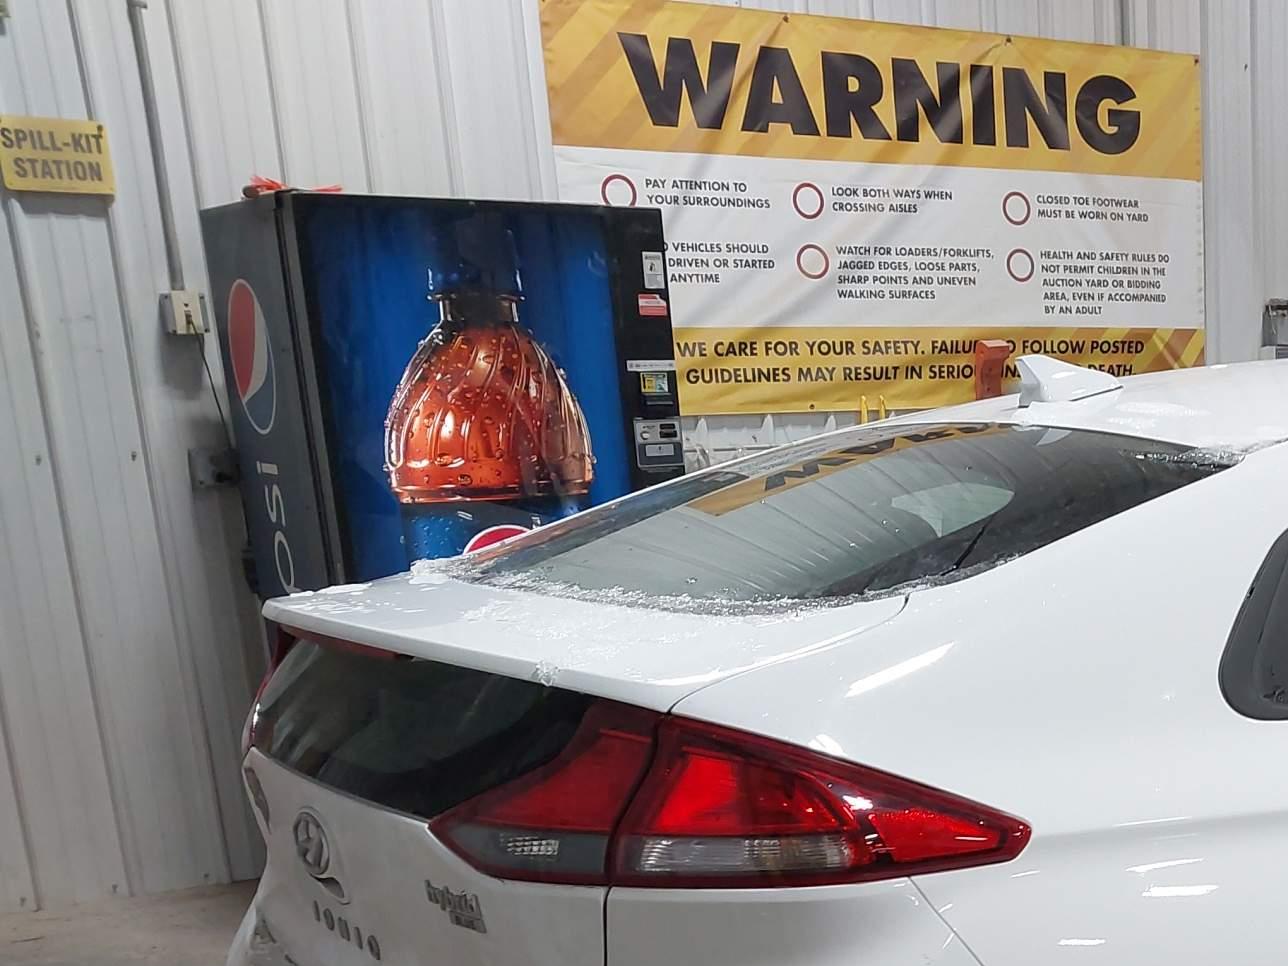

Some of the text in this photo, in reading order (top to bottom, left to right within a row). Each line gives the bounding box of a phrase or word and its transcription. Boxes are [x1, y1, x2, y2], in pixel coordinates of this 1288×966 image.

[617, 32, 1141, 155] WARNING
[0, 127, 103, 154] SPILL-KIT
[13, 157, 103, 182] STATION
[645, 178, 748, 193] PAY ATTENTION TO
[832, 187, 953, 200] LOOK BOTH WAYS WHEN
[647, 194, 771, 209] YOUR SURROUNDINGS
[832, 202, 918, 213] CROSSING AISLES
[1037, 195, 1139, 208] CLOSED TOE FOOTWEAR
[1037, 209, 1149, 222] MUST BE WORN ON YARD
[672, 242, 722, 253] VEHICLES
[726, 243, 769, 254] SHOULD
[836, 246, 995, 259] WATCH FOR LOADERS/FORKLIFTS,
[668, 257, 775, 269] DRIVEN OR STARTED
[1040, 250, 1170, 263] HEALTH AND SAFETY RULES DO
[837, 261, 981, 273] JAGGED EDGES, LOOSE PARTS,
[1041, 264, 1166, 276] NOT PERMIT CHILDREN IN THE
[670, 273, 720, 283] ANYTIME
[837, 275, 976, 286] SHARP POINTS AND UNEVEN
[1042, 278, 1161, 289] AUCTION YARD OR BIDDING
[836, 289, 936, 299] WALKING SURFACES
[1043, 292, 1167, 303] AREA, EVEN IF ACCOMPANIED
[1044, 305, 1103, 315] BY AN ADULT
[676, 341, 707, 357] WE
[713, 341, 758, 357] CARE
[764, 341, 800, 357] FOR
[805, 340, 856, 356] YOUR
[861, 340, 925, 356] SAFETY.
[931, 340, 977, 354] FAILU
[1022, 340, 1085, 354] FOLLOW
[1090, 340, 1145, 354] POSTED
[686, 367, 791, 384] GUIDELINES
[797, 367, 836, 382] MAY
[842, 365, 900, 381] RESULT
[905, 365, 922, 380] IN
[928, 364, 976, 379] SERIO
[256, 460, 302, 596] psi
